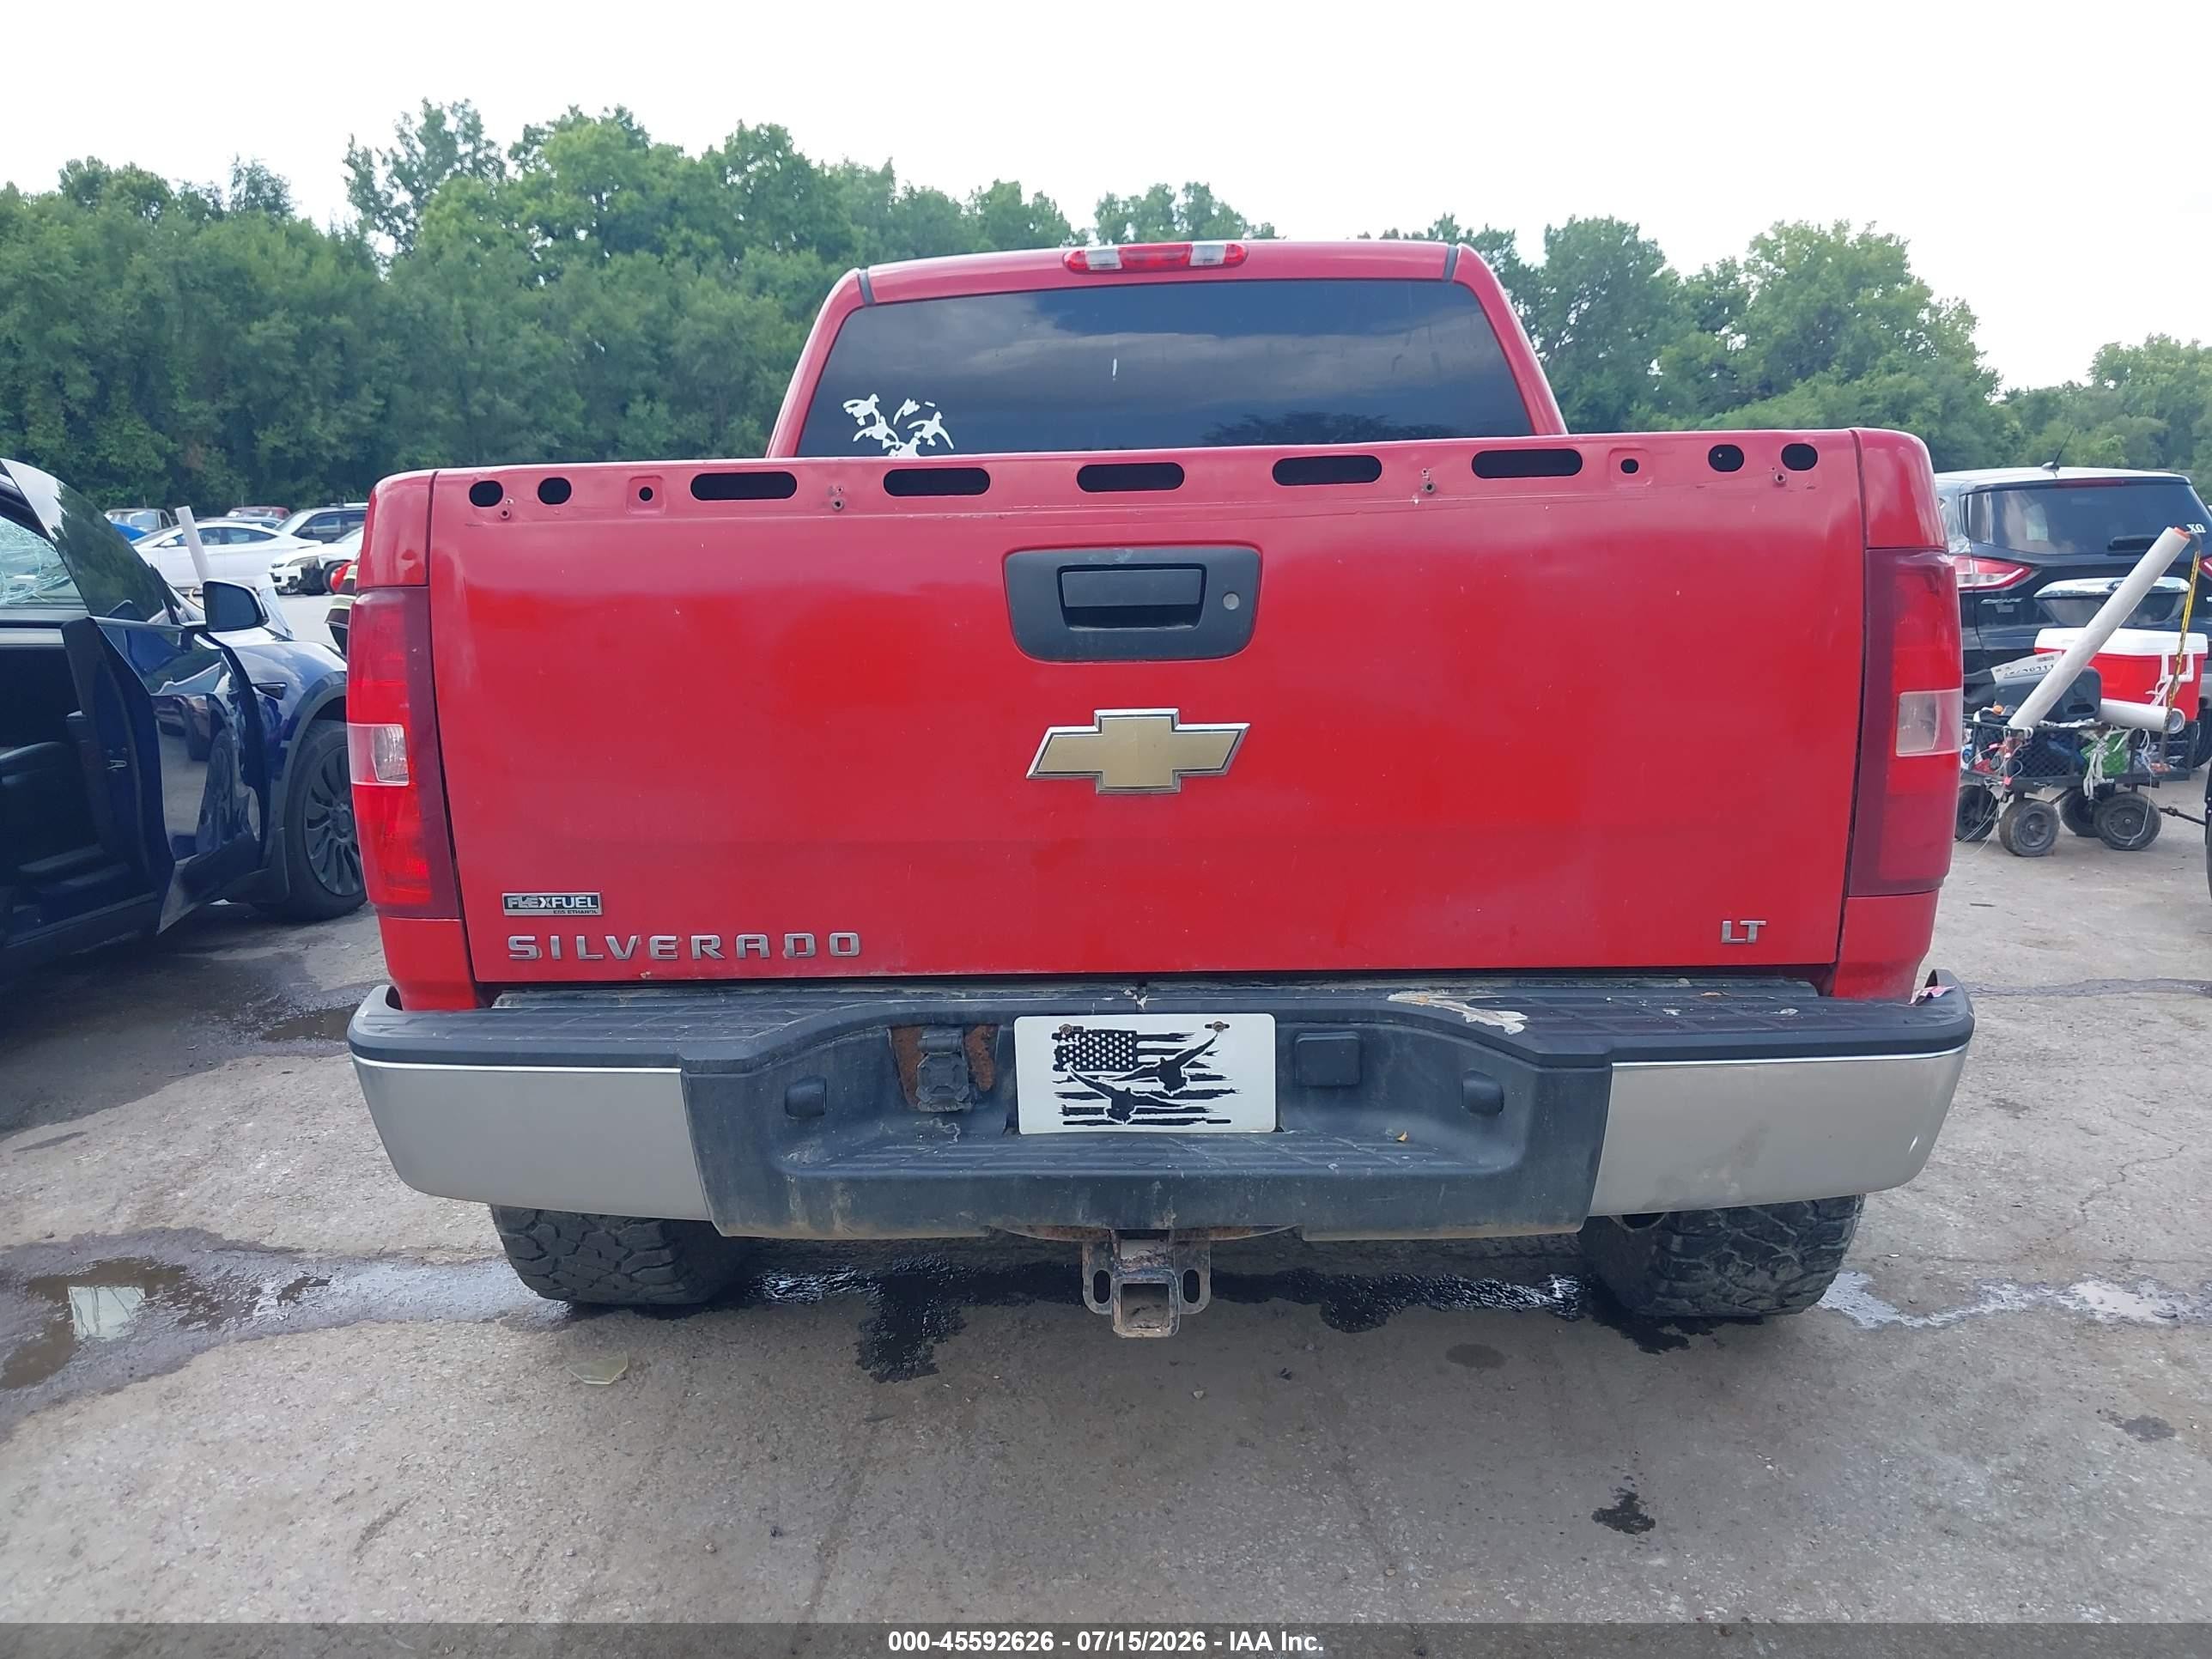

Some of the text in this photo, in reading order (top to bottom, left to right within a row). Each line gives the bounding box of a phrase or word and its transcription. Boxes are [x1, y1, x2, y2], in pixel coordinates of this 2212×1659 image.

[507, 896, 598, 908] FLEXFUEL
[1721, 920, 1767, 944] LT
[507, 932, 861, 960] SILVERADO
